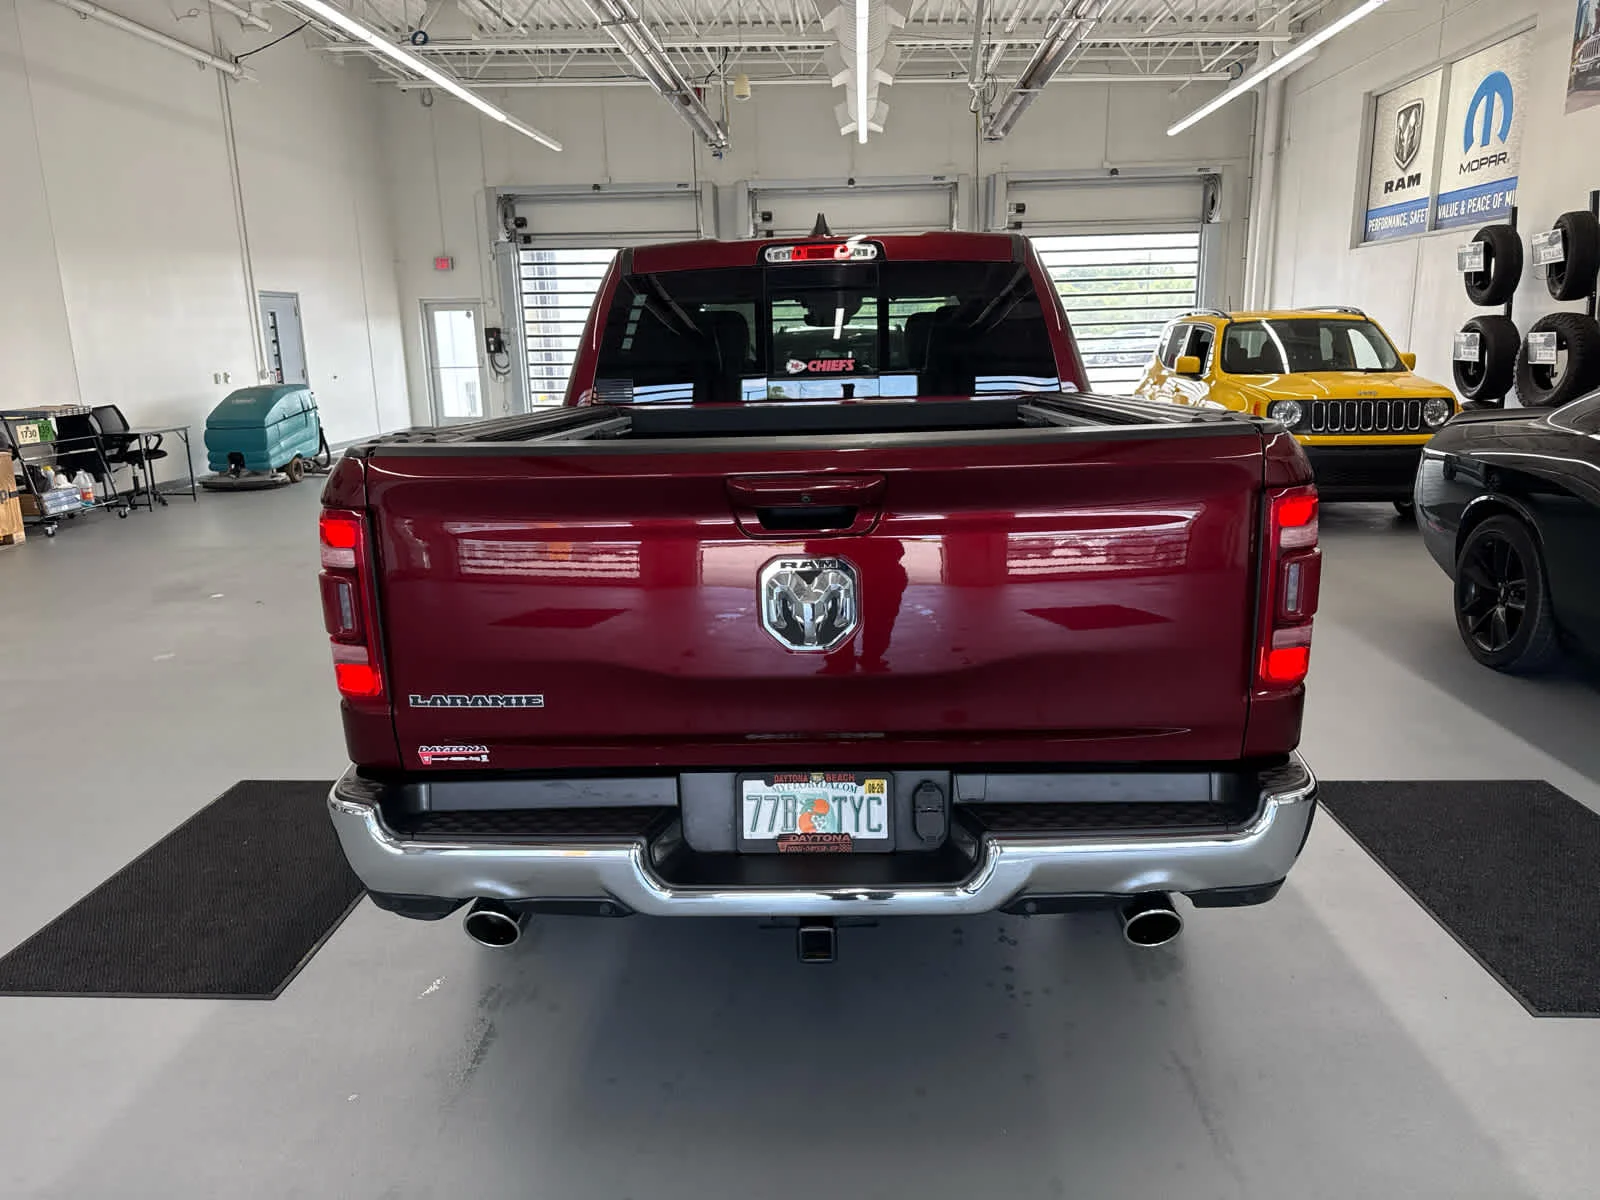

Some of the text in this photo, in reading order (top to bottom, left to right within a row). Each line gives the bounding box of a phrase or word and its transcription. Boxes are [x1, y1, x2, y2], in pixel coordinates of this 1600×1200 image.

[1459, 152, 1507, 175] MOPAR
[1384, 173, 1421, 194] RAM
[1410, 207, 1429, 225] SAFET
[1438, 201, 1460, 220] VALUE
[1460, 200, 1466, 215] &
[1467, 194, 1492, 214] PEACE
[1492, 191, 1504, 209] OF
[1504, 189, 1516, 207] MI
[808, 359, 855, 372] CHIEFS
[20, 429, 37, 439] 1730
[780, 559, 838, 569] RAM
[409, 694, 544, 708] LARAMIE
[419, 745, 489, 753] DAYTONA
[774, 773, 856, 783] DAYTONA BEACH
[832, 795, 882, 833] TYC
[790, 834, 851, 842] DAYTONA
